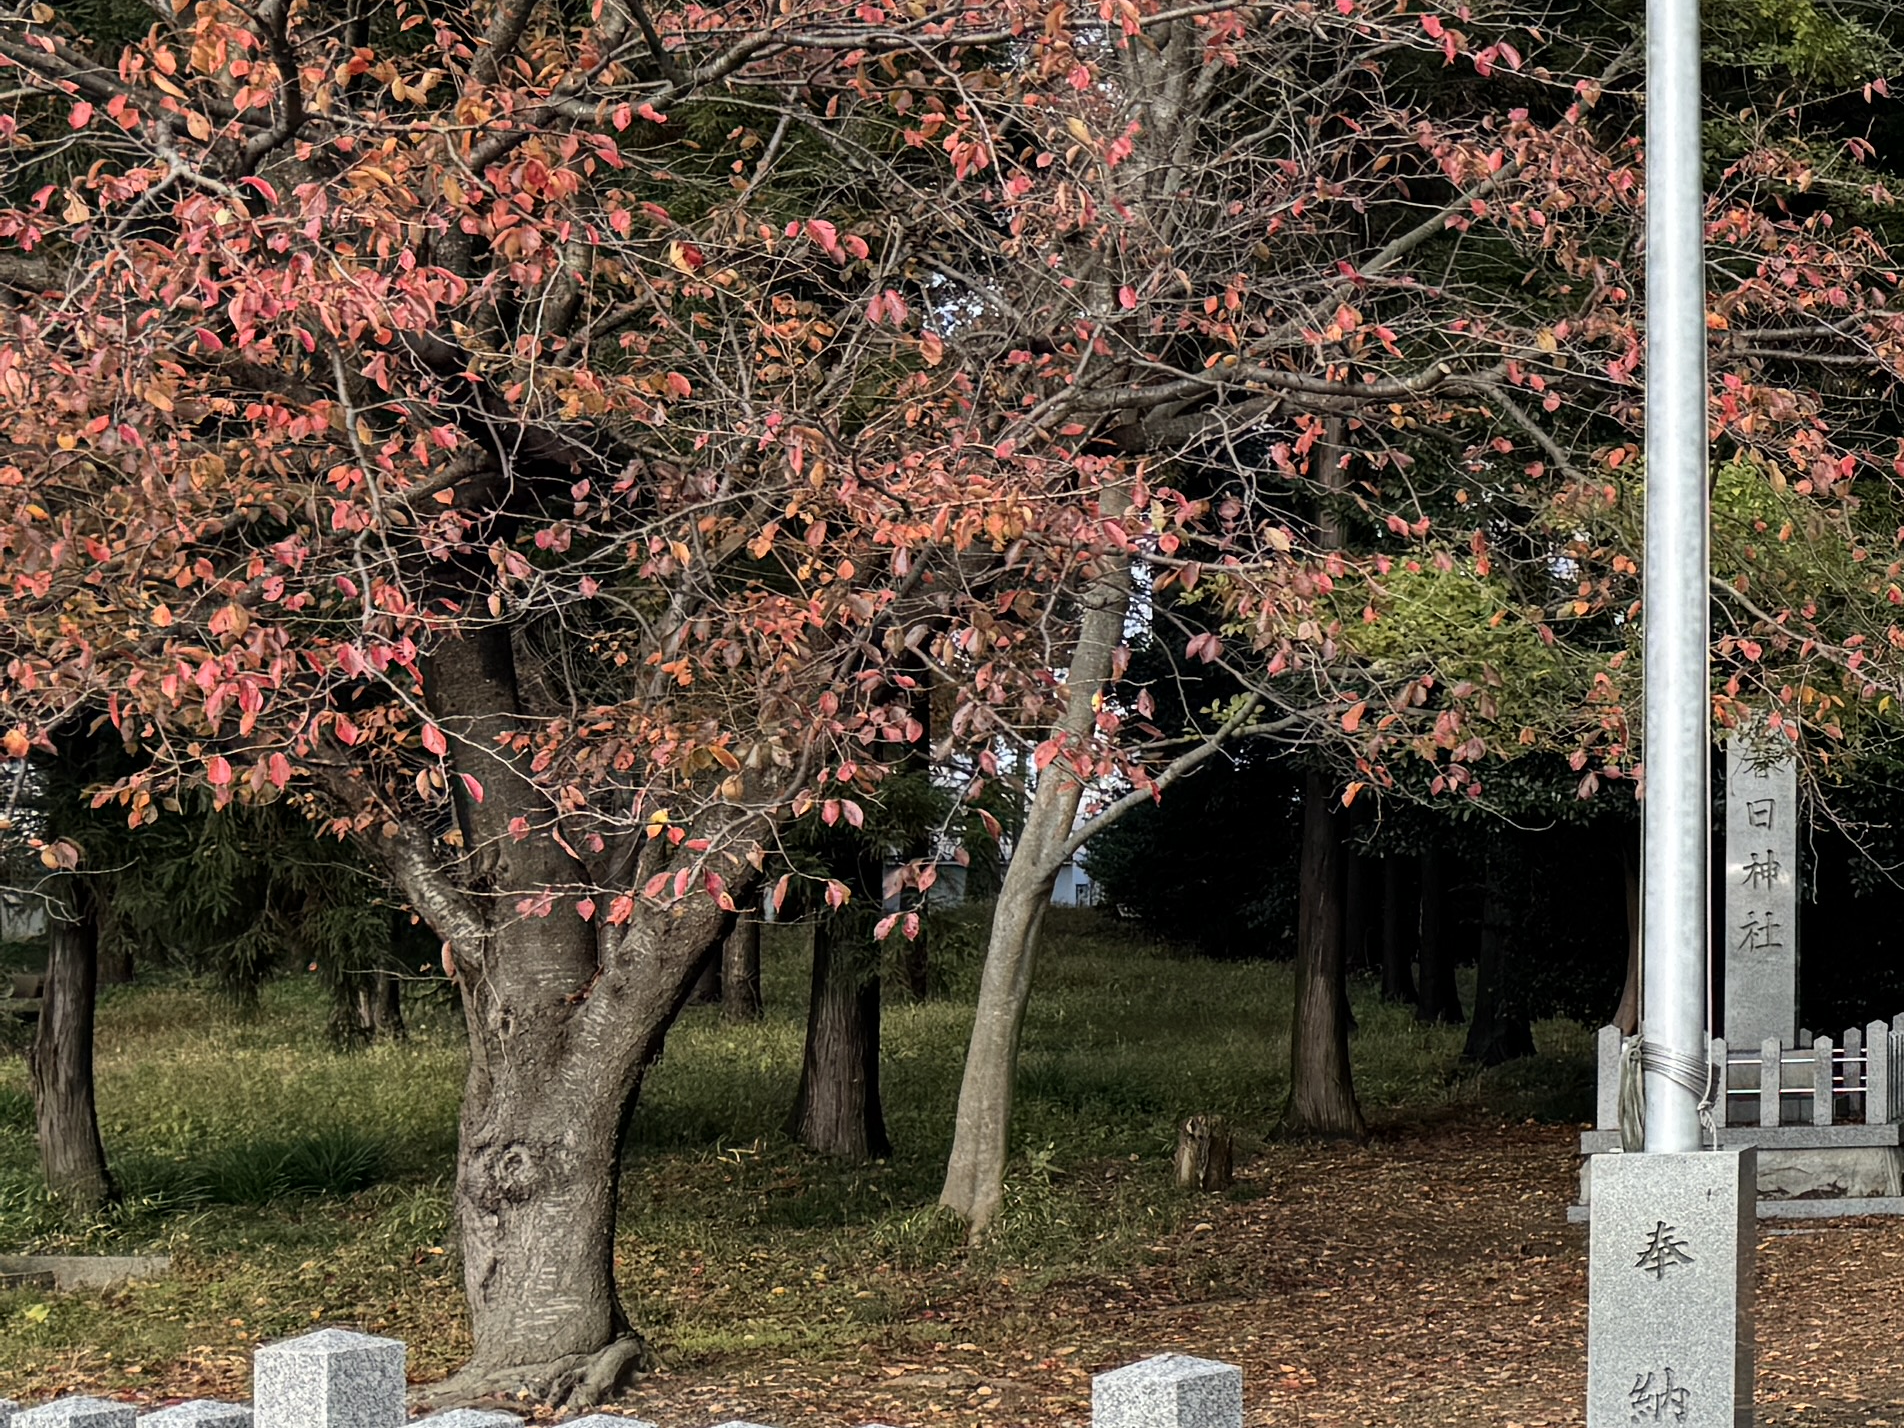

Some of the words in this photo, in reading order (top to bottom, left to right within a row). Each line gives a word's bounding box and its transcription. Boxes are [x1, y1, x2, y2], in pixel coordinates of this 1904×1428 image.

[1738, 738, 1784, 953] 春日神社
[1628, 1220, 1696, 1423] 奉納
